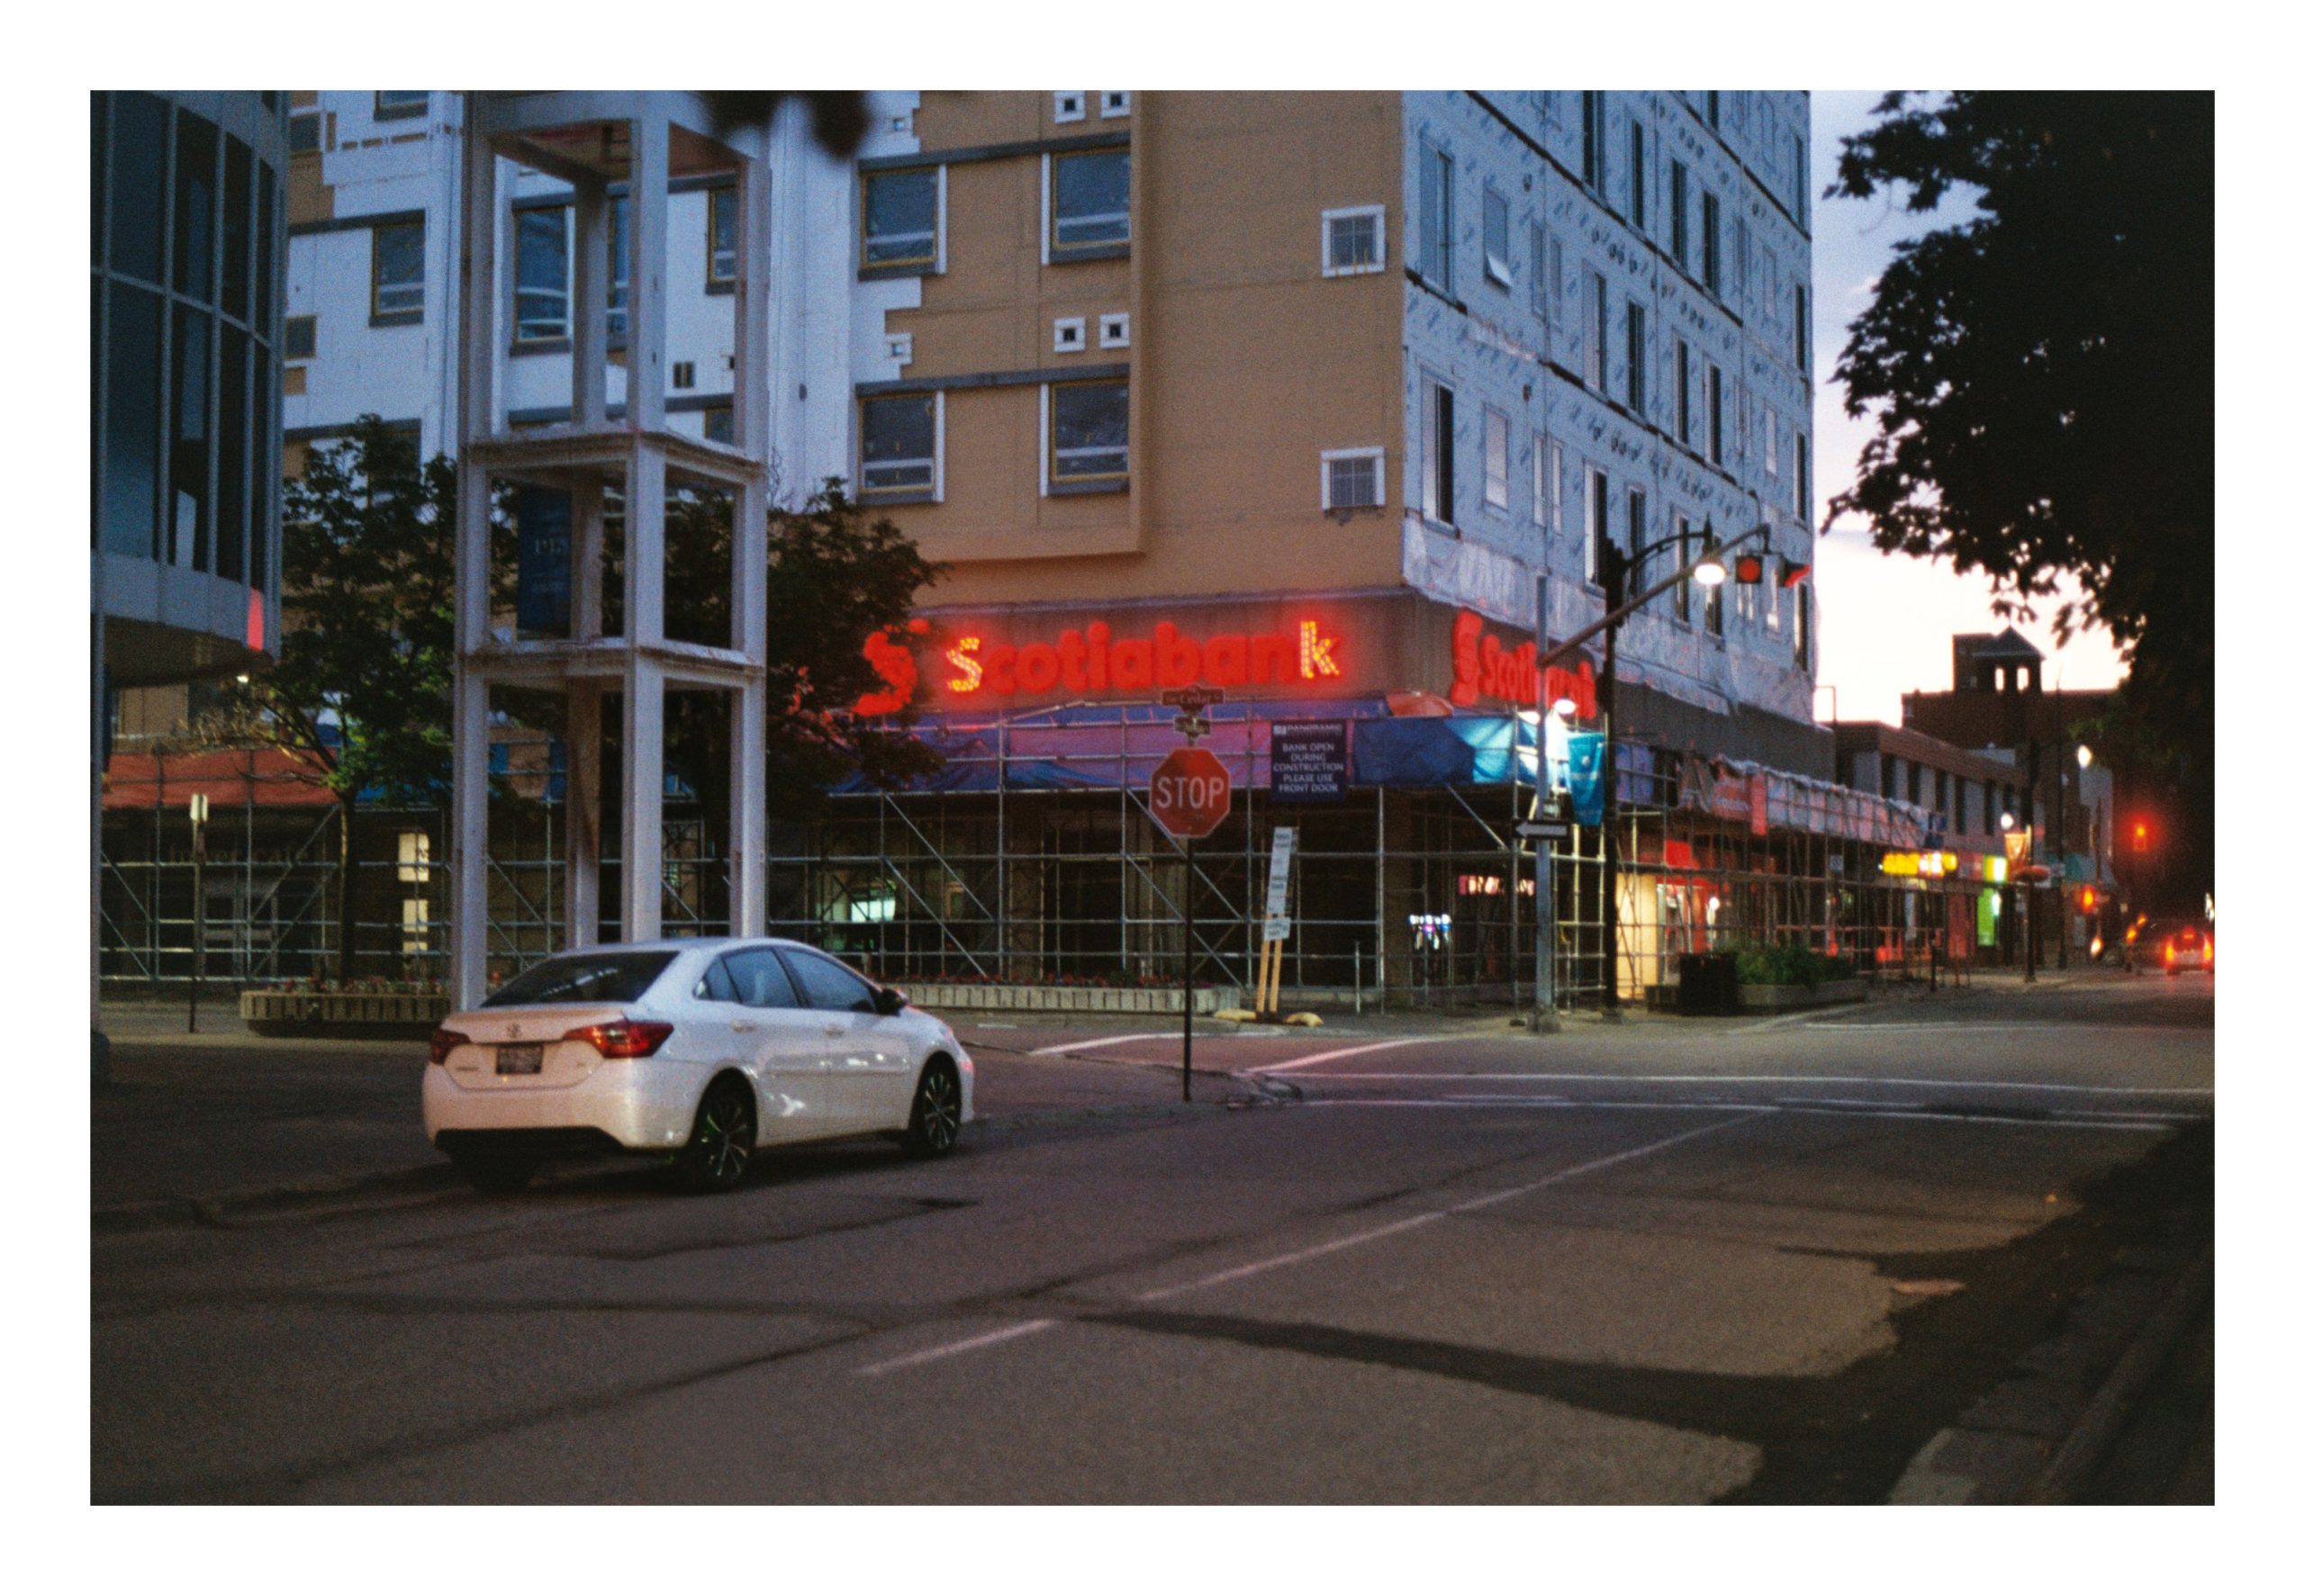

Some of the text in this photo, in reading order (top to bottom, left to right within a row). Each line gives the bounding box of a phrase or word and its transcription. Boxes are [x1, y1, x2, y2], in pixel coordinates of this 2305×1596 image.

[946, 619, 1341, 695] Scotiabank
[1282, 743, 1334, 753] BANK OPEN
[1290, 753, 1326, 762] DURING
[1273, 762, 1344, 771] CONSTRUCTION
[1283, 773, 1333, 782] PLEASE USE
[1155, 776, 1225, 808] STOP
[1279, 783, 1339, 793] FRONT DOOR
